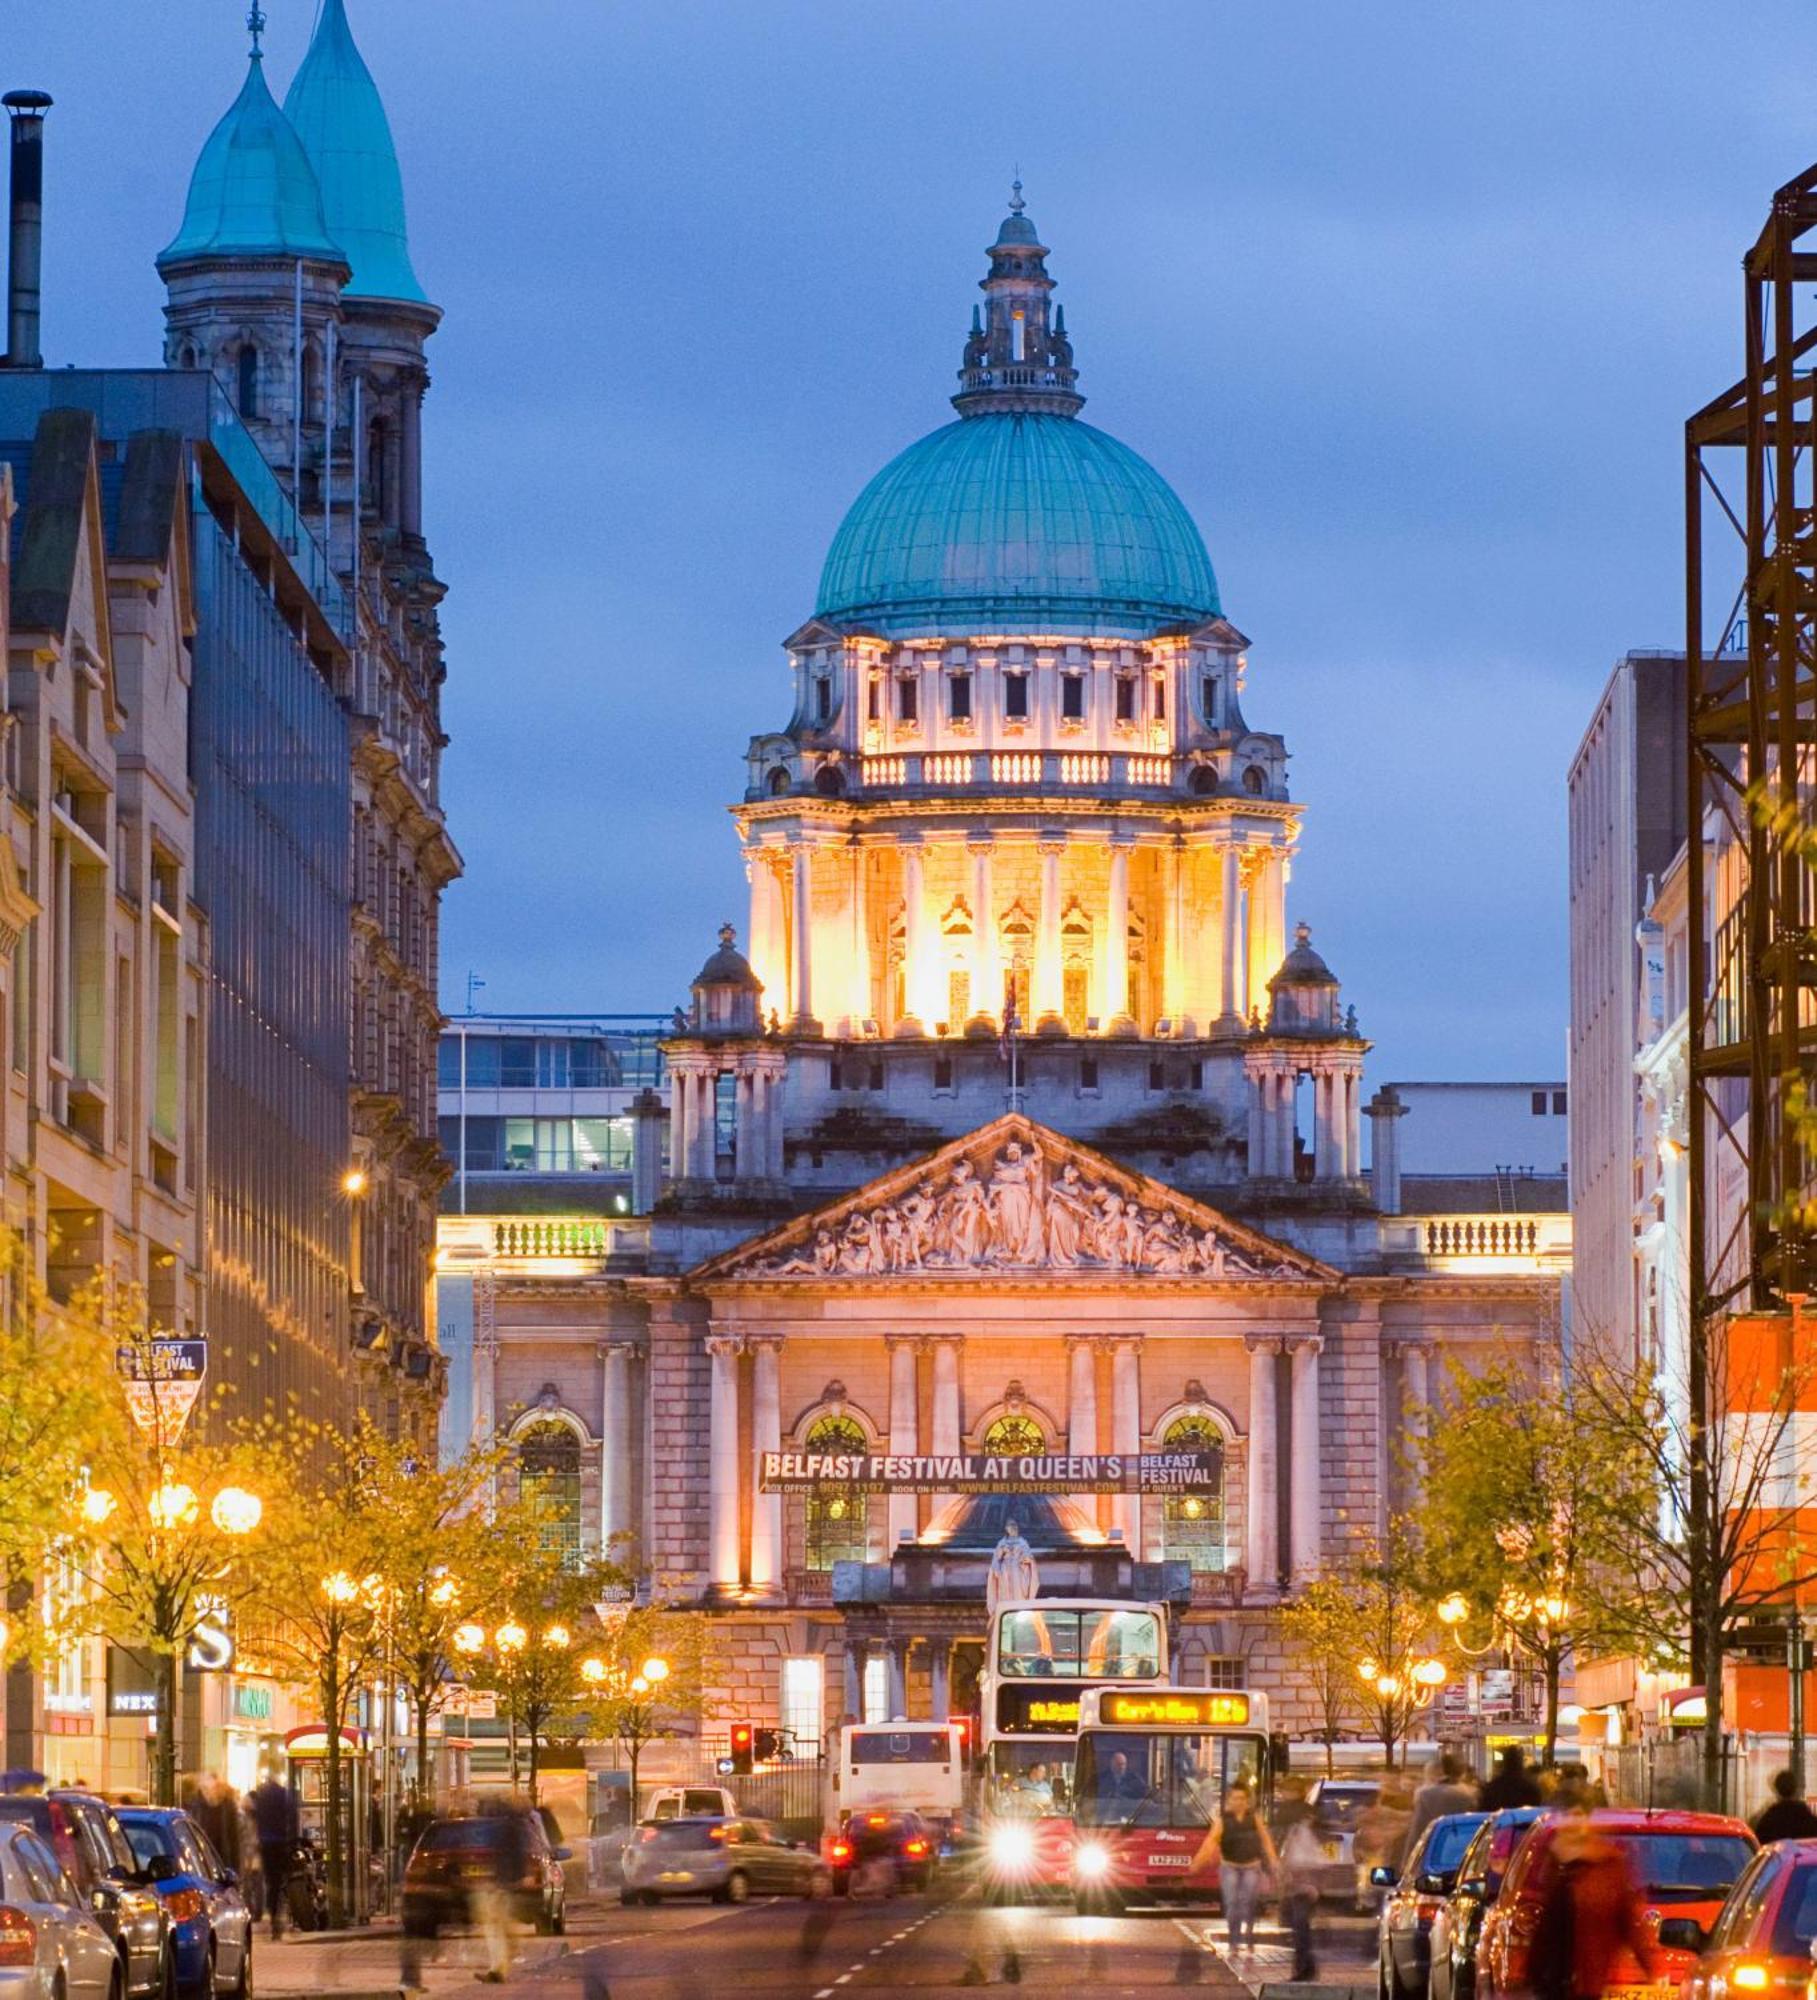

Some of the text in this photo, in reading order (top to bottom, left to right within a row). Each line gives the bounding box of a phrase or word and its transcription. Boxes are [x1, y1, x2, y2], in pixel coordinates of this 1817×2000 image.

[765, 1453, 1122, 1480] BELFAST FESTIVAL AT QUEEN'S
[1140, 1454, 1198, 1468] BELFAST
[1140, 1468, 1212, 1484] FESTIVAL
[1140, 1484, 1185, 1493] AT QUEEN'S
[191, 1608, 232, 1669] S
[115, 1695, 155, 1710] NEX
